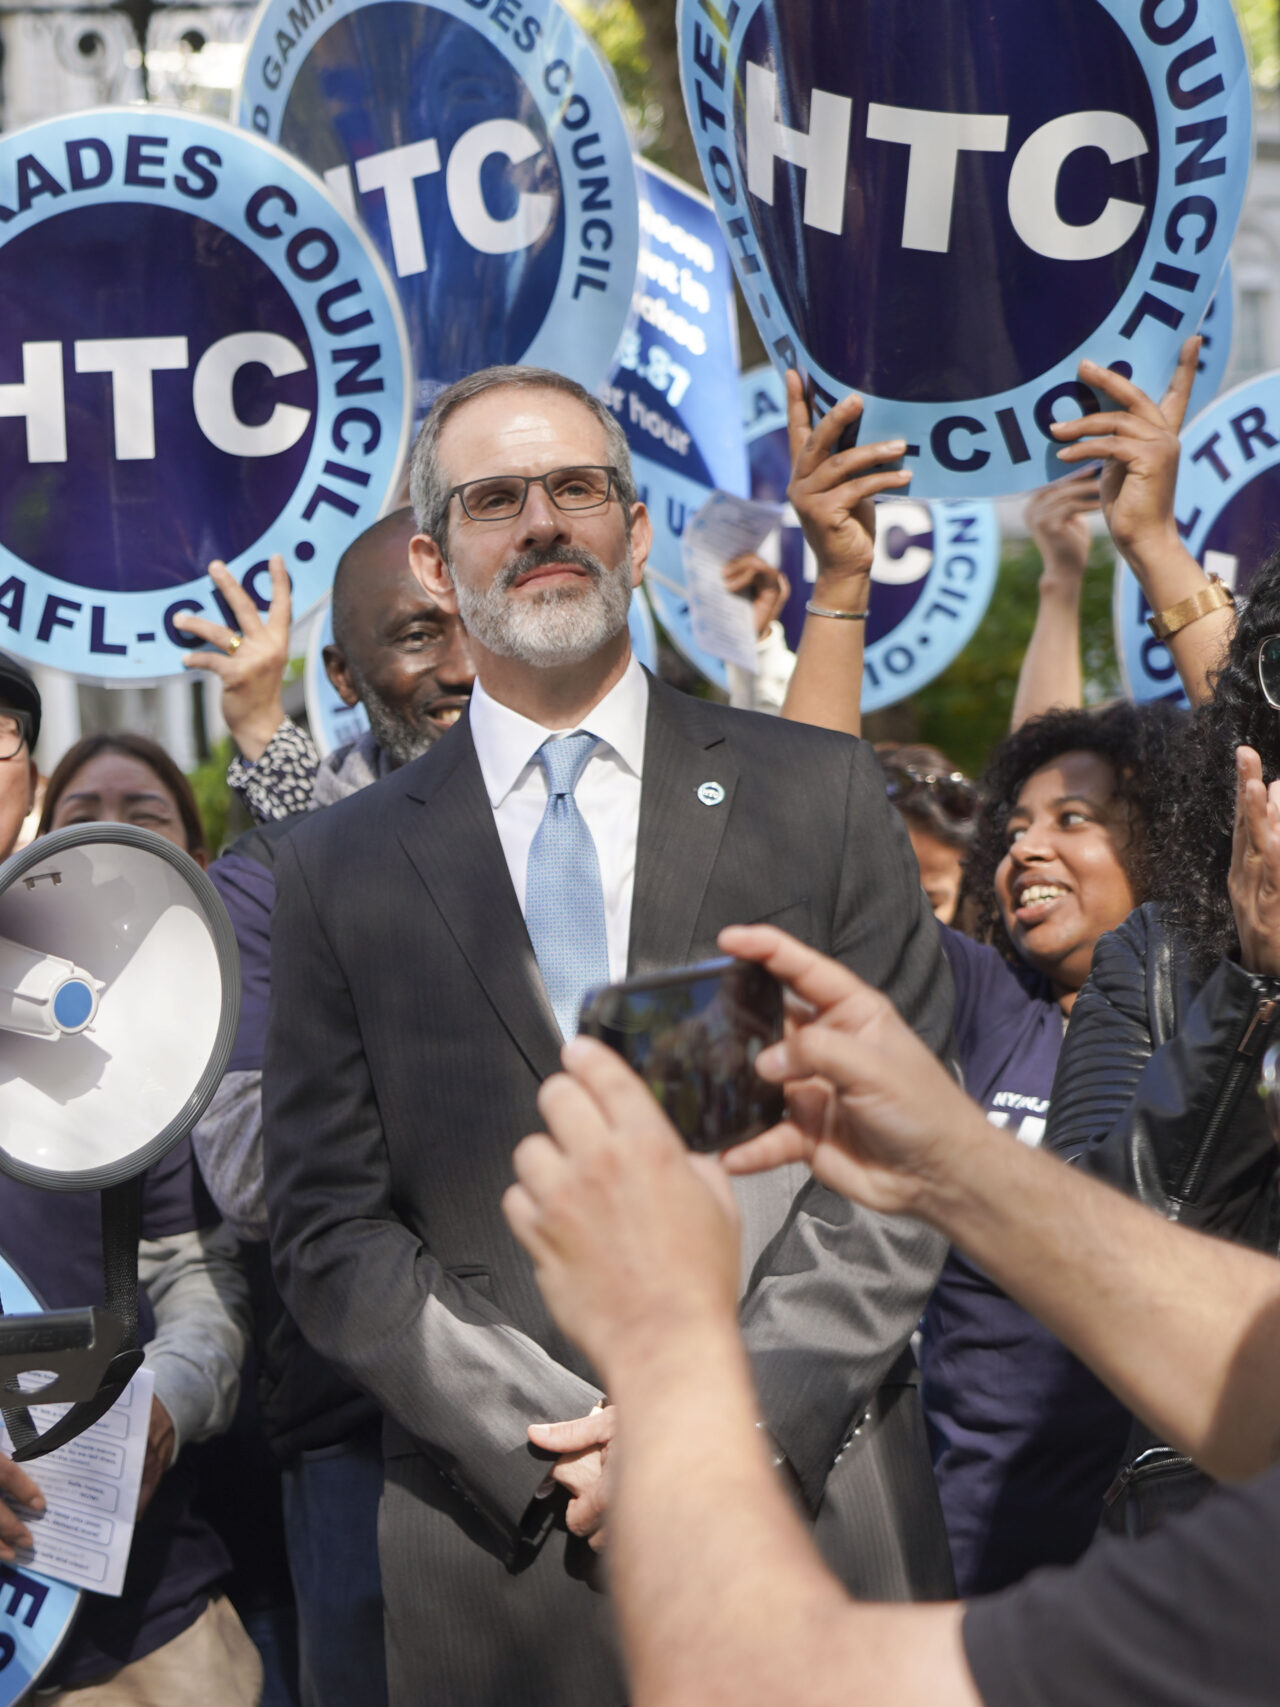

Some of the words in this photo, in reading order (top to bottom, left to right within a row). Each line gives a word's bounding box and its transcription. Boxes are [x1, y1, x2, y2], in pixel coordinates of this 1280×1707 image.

[544, 59, 613, 301] COUNCIL
[746, 60, 1149, 261] HTC
[245, 185, 385, 523] COUNCIL
